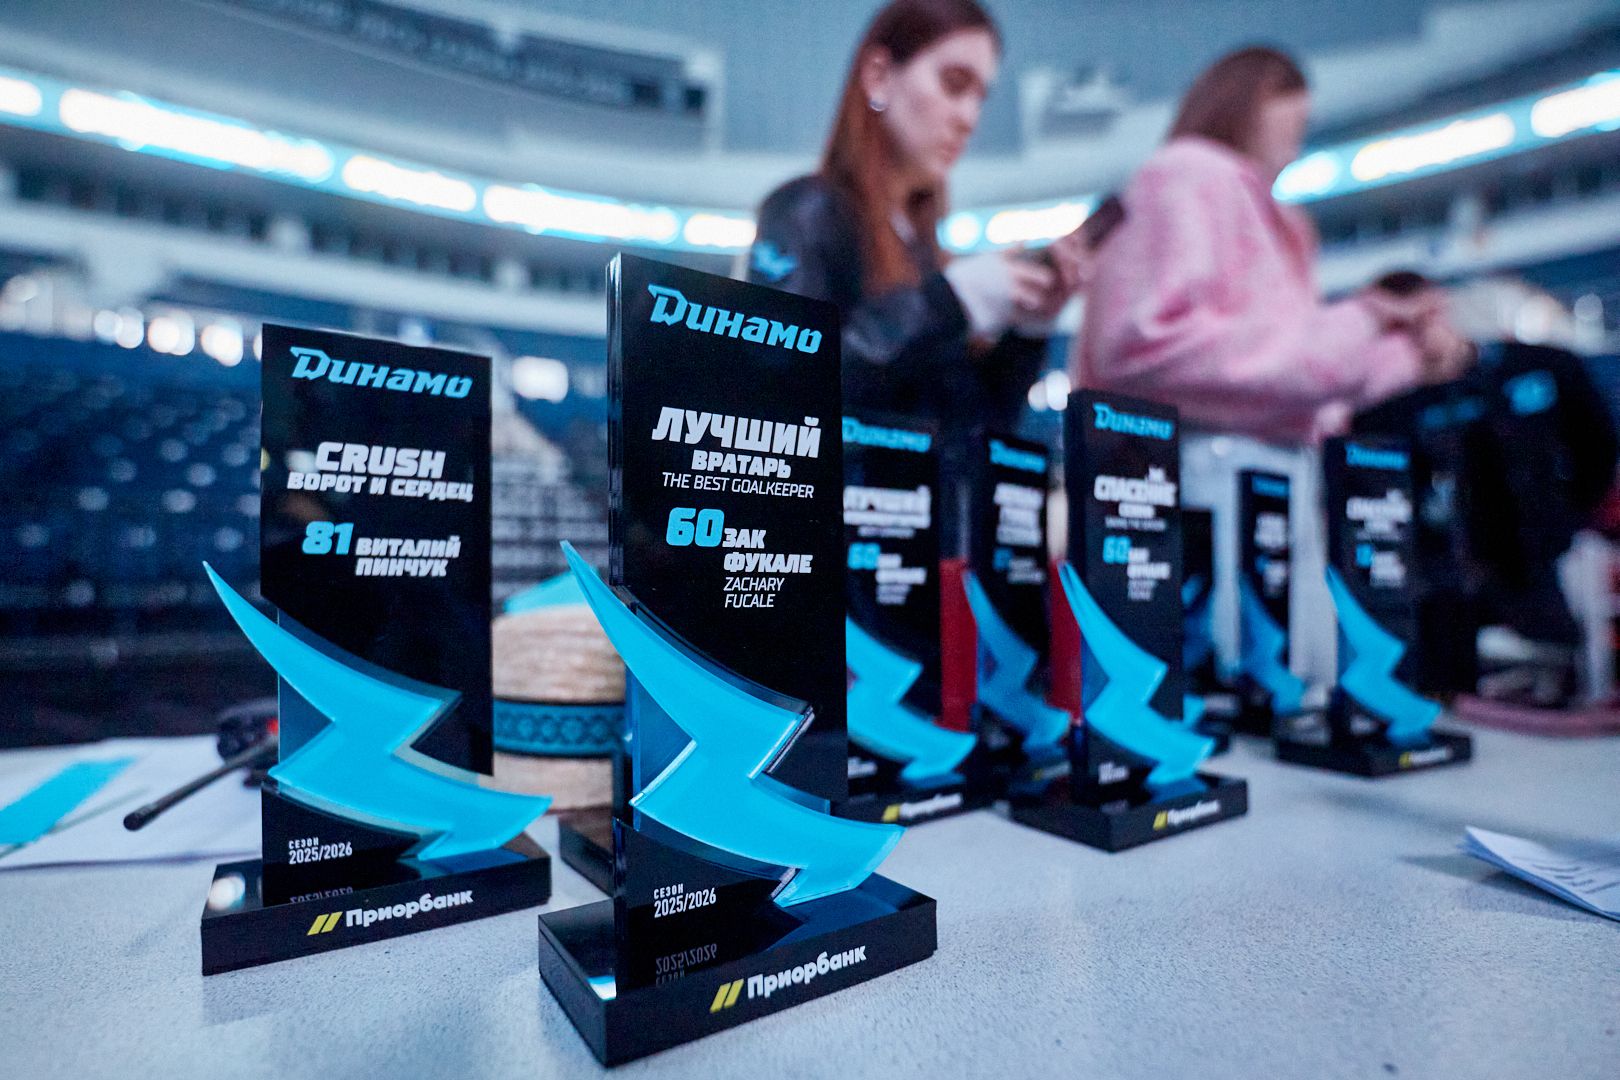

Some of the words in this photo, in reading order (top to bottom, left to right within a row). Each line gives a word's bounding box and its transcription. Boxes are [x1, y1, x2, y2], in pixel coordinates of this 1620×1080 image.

[651, 406, 822, 458] ЛУЧШИЙ
[315, 441, 446, 479] CRUSH
[691, 450, 791, 478] ВРАТАРЬ
[287, 472, 367, 494] ВОРОТ
[369, 477, 387, 495] И
[390, 479, 474, 502] СЕРДЕЦ
[662, 471, 691, 489] THE
[694, 475, 730, 491] BEST
[731, 479, 815, 498] GOALKEEPER
[302, 521, 354, 555] 81
[355, 535, 461, 558] ВИТАЛИЙ
[666, 507, 725, 547] 60
[722, 528, 767, 549] ЗАК
[355, 558, 449, 577] ПИНЧУК
[723, 551, 814, 574] ФУКАЛЕ
[723, 577, 785, 591] ZACHARY
[724, 594, 775, 608] FUCALE
[288, 837, 319, 849] СЕЗОН
[288, 841, 353, 865] 2025/2026
[654, 884, 684, 899] СЕЗОН
[654, 887, 717, 918] 2025/2026
[345, 890, 474, 928] Приорбанк
[747, 945, 867, 998] Приорбанк
